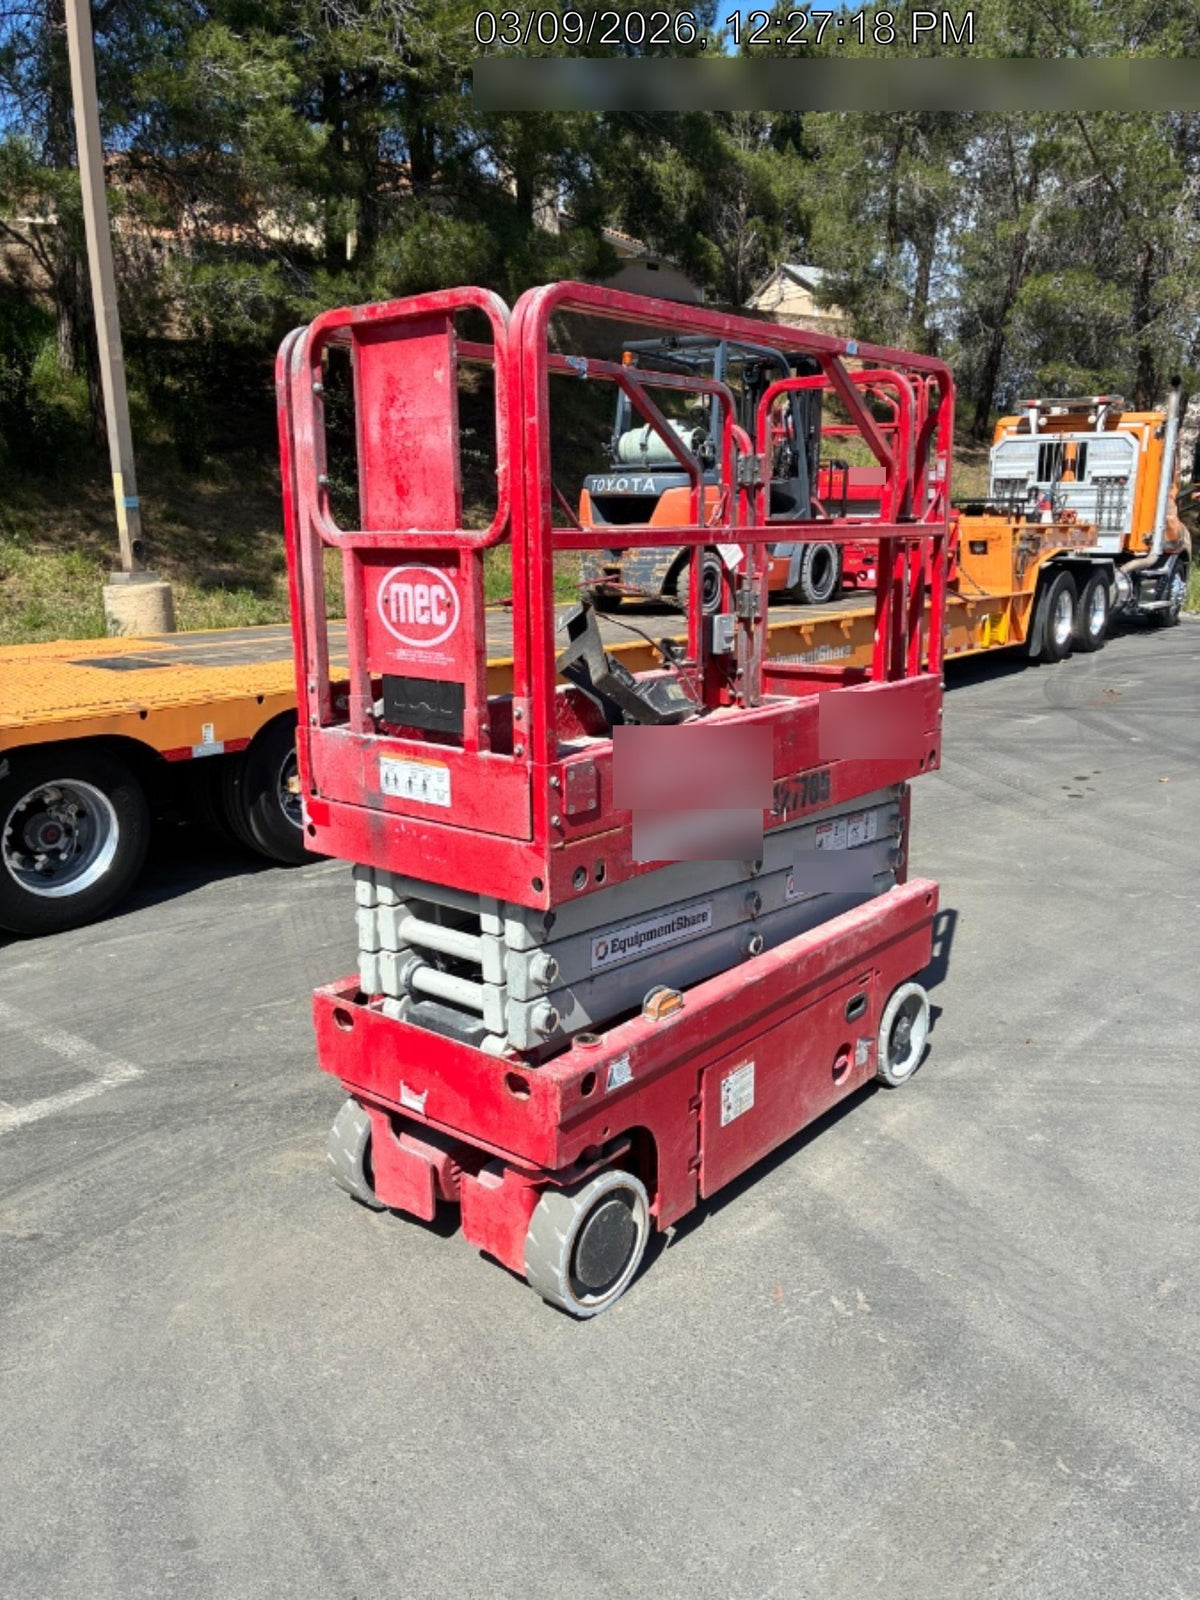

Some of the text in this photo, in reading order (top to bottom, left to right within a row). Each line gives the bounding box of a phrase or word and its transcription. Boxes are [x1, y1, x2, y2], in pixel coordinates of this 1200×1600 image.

[591, 477, 656, 492] TOYOTA
[389, 582, 448, 626] mec
[610, 911, 708, 954] EquipmentShare
